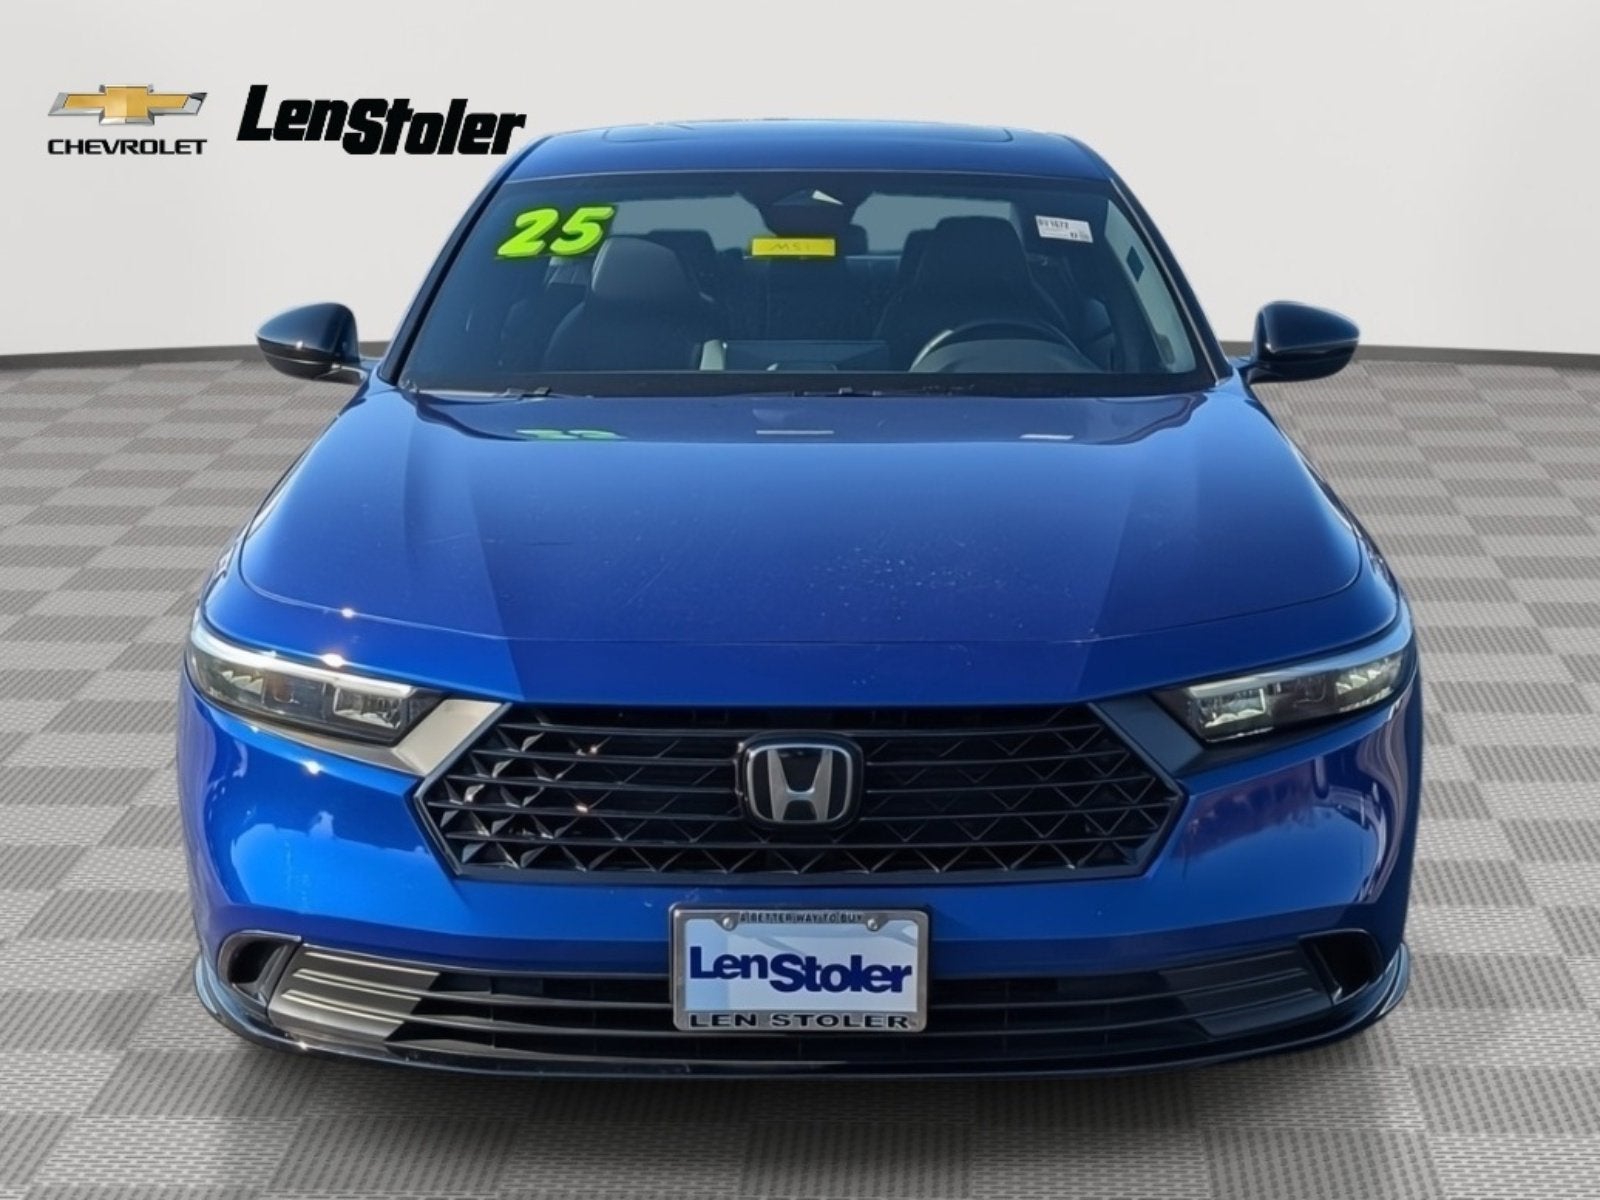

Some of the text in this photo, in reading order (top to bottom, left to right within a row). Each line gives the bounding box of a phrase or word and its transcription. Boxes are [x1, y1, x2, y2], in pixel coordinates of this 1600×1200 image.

[497, 206, 615, 257] 25
[749, 912, 794, 923] BETTER
[796, 912, 818, 923] WAY
[823, 912, 837, 923] TO
[840, 912, 862, 923] BUY
[690, 1013, 910, 1029] LEN STOLER
